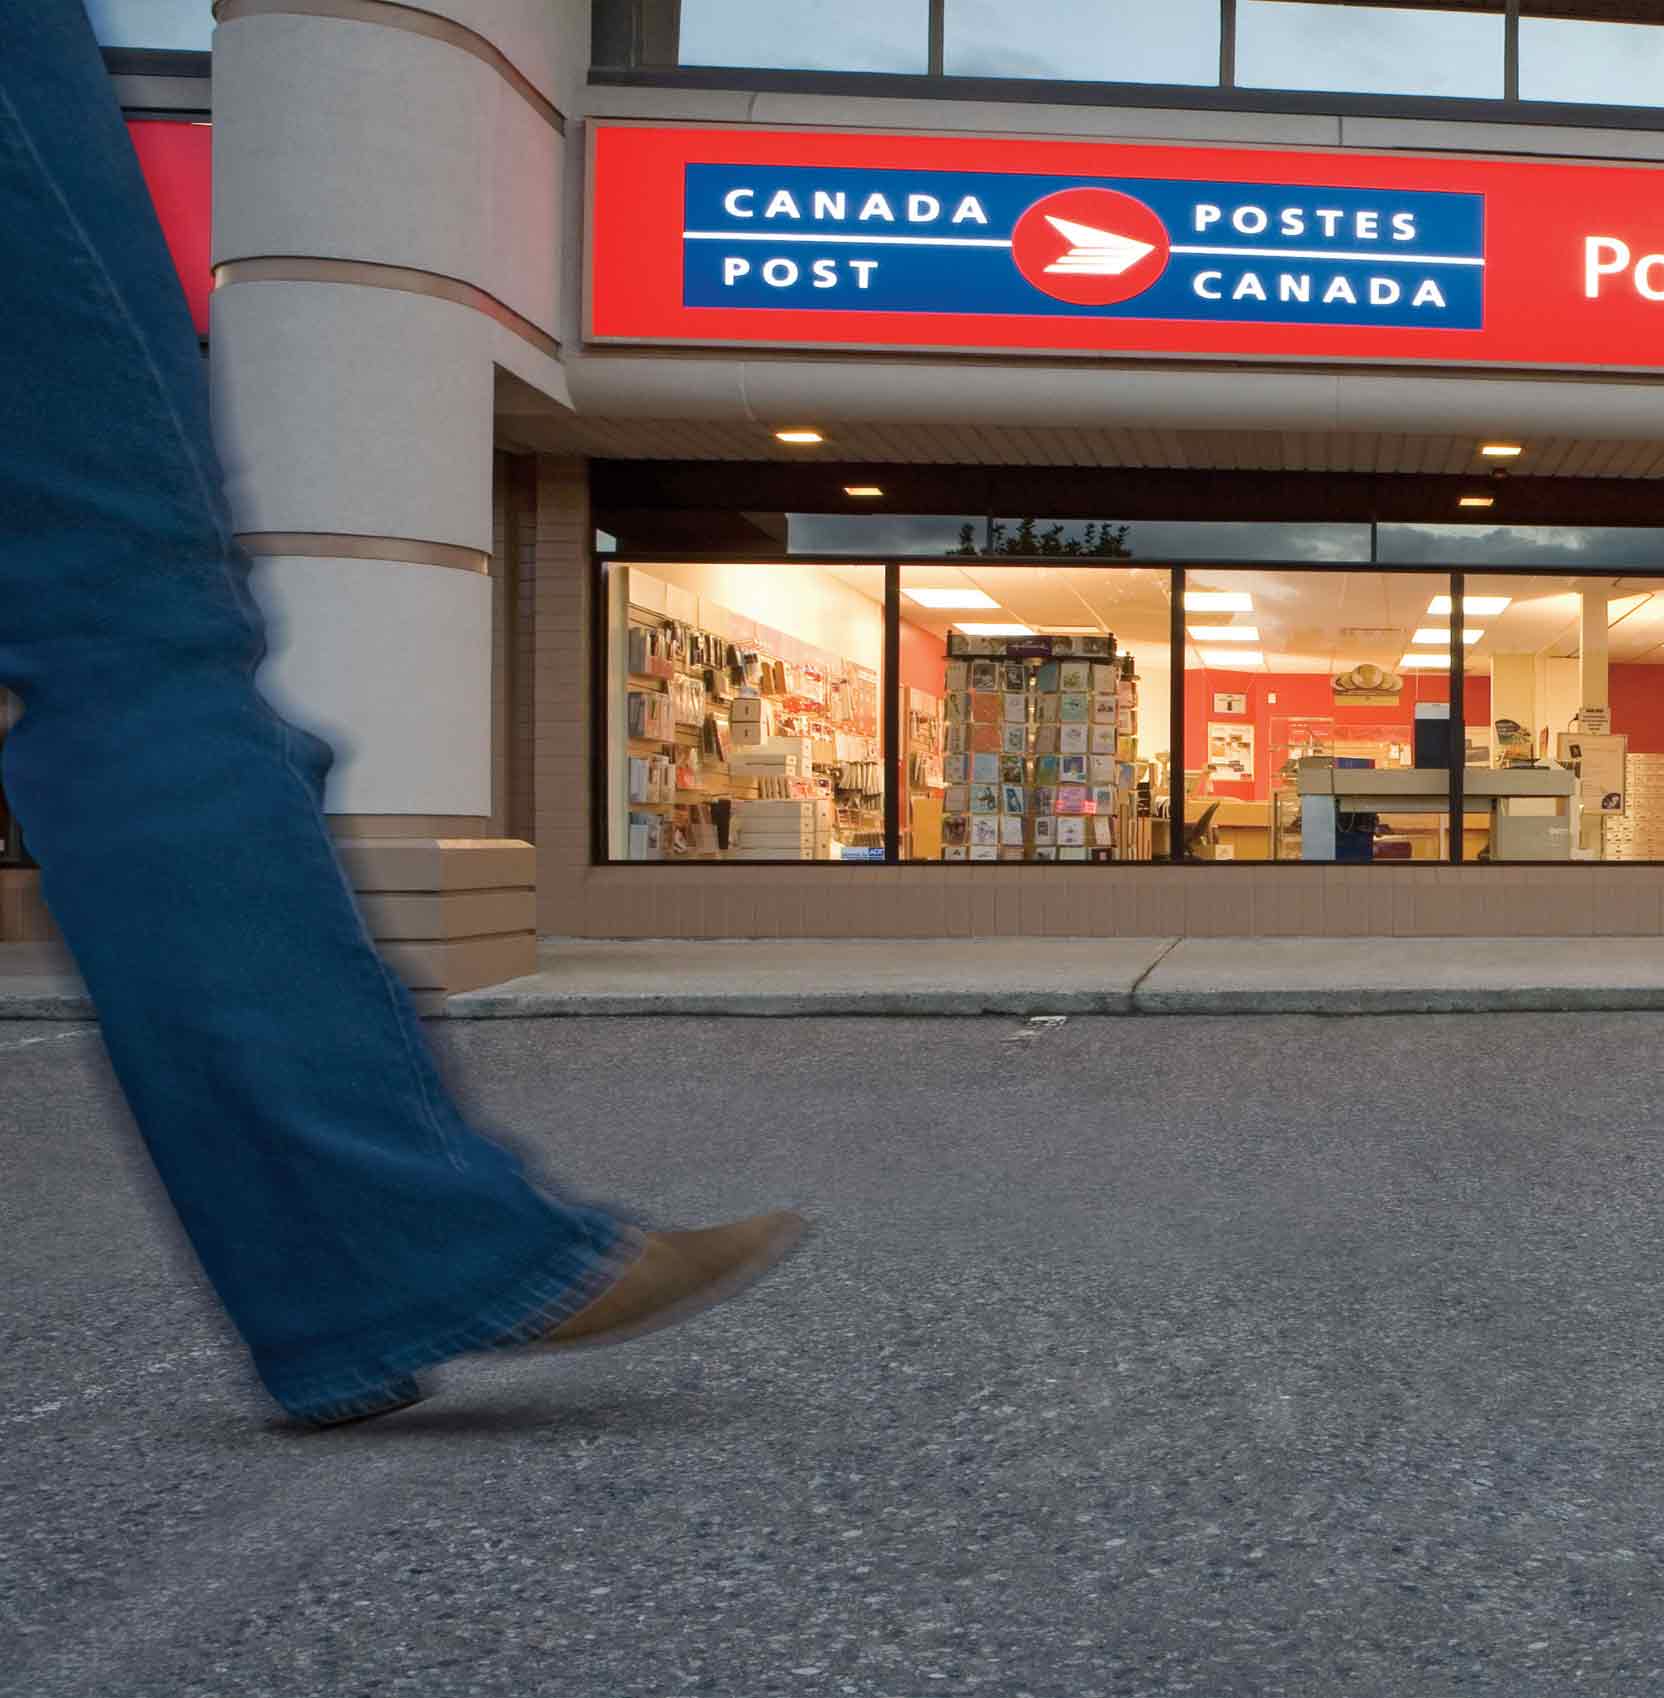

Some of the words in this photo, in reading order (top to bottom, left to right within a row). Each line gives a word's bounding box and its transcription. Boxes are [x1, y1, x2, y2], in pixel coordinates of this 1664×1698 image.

[723, 187, 989, 224] CANADA
[1194, 203, 1418, 241] POSTES
[723, 256, 880, 290] POST
[1192, 270, 1448, 308] CANADA
